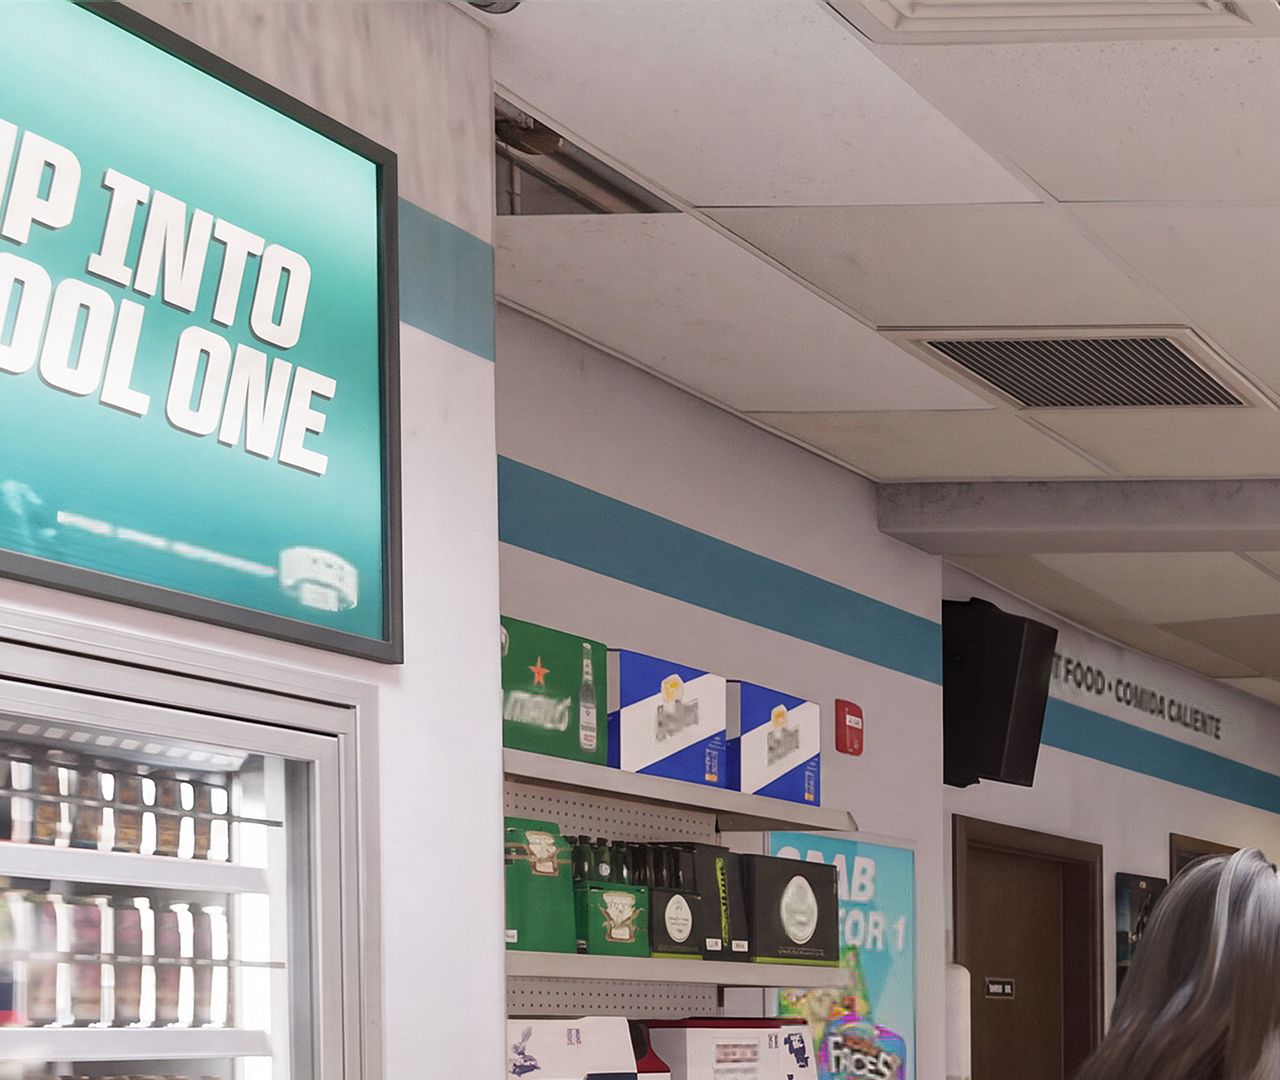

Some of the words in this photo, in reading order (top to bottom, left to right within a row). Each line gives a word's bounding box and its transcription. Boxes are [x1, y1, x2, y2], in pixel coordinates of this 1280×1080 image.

[87, 167, 312, 350] INTO
[165, 325, 337, 476] ONE
[1063, 656, 1106, 695] FOOD
[1115, 678, 1166, 719] COMIDA
[1168, 698, 1221, 740] CALIENTE
